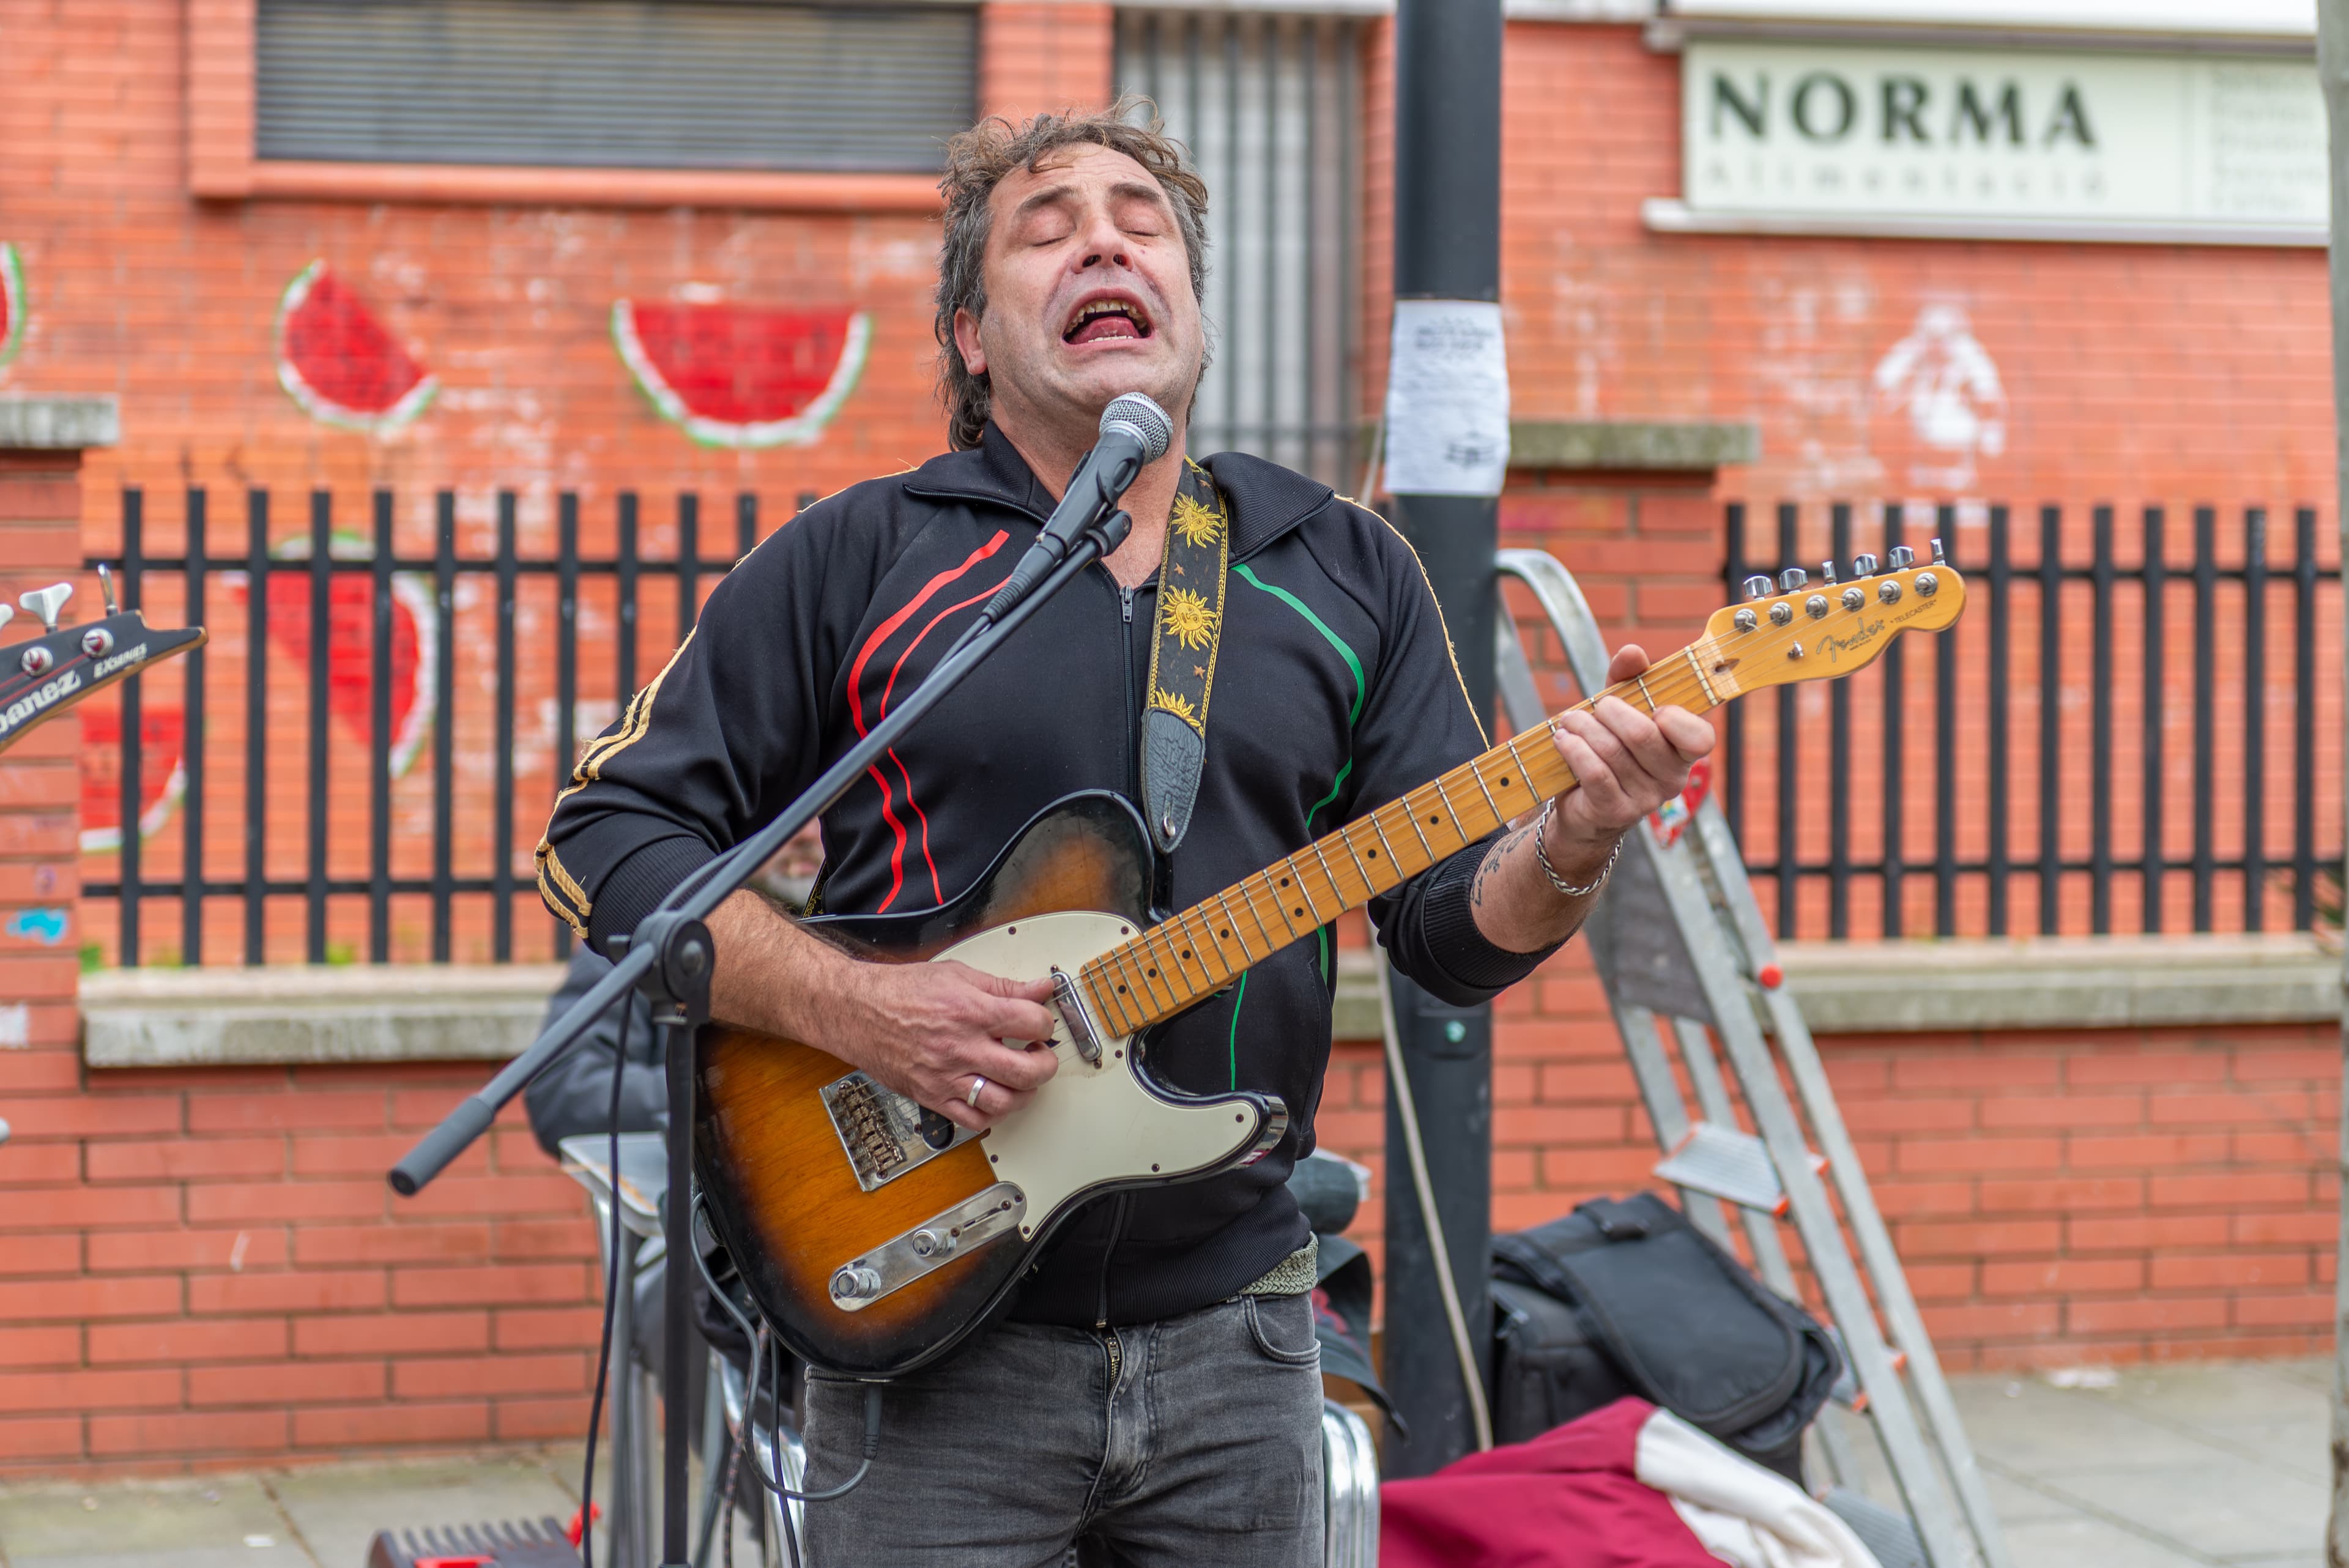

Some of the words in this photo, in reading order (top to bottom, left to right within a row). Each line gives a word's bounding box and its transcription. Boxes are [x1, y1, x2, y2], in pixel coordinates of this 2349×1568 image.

[1710, 69, 2098, 148] NORMA
[1893, 600, 1934, 623] TELECASTER
[1816, 617, 1885, 663] Fender
